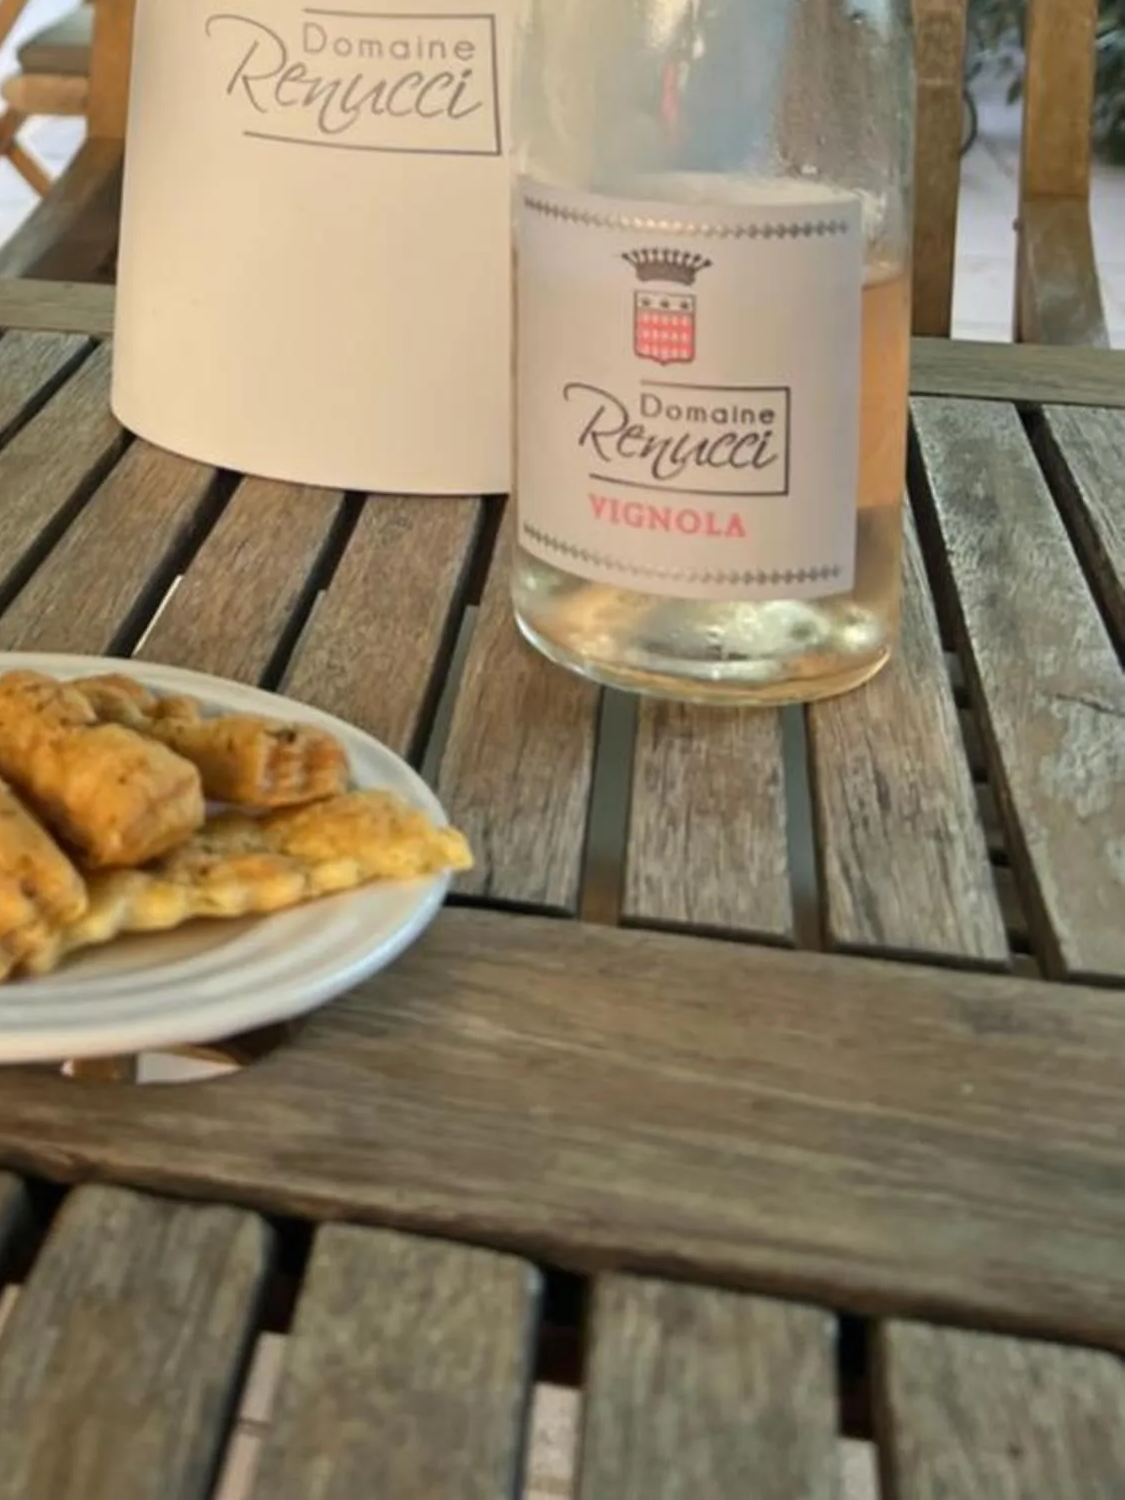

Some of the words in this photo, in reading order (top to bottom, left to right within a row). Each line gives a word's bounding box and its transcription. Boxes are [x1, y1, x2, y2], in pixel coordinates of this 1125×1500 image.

[303, 23, 476, 61] Domaine
[205, 14, 483, 134] Renucci
[564, 383, 779, 480] Renucci
[640, 394, 776, 426] Domaine
[588, 493, 747, 539] VIGNOLA
